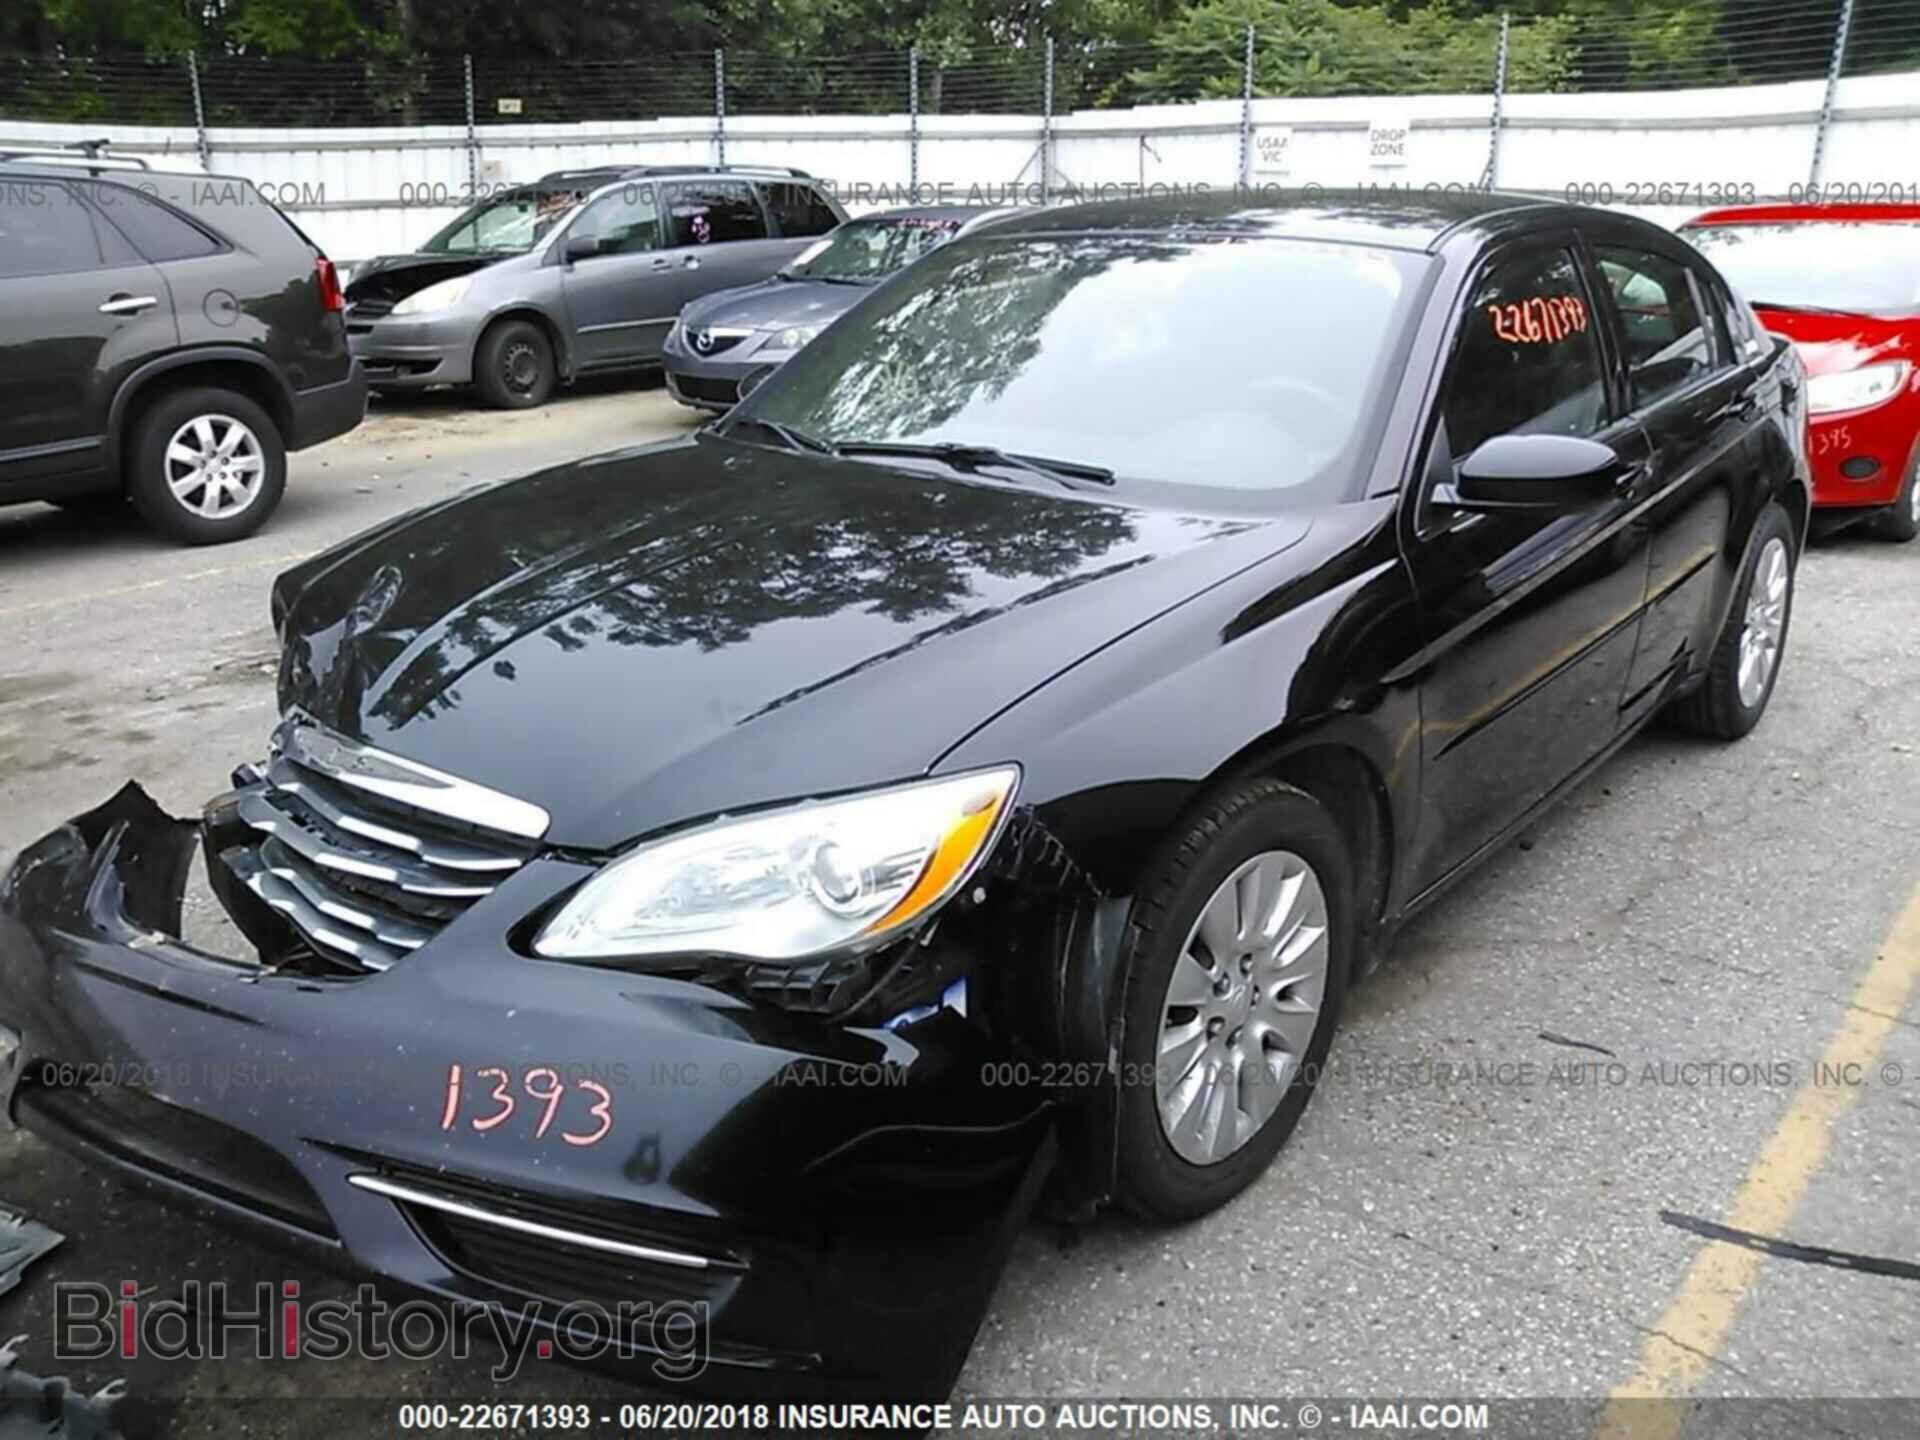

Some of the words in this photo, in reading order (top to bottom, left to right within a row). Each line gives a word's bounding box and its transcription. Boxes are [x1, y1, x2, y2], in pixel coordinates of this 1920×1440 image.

[1371, 129, 1407, 142] DROP
[1262, 150, 1281, 162] VIC
[1370, 143, 1405, 156] ZONE
[1488, 296, 1587, 344] 22671393
[441, 1064, 613, 1146] 1393
